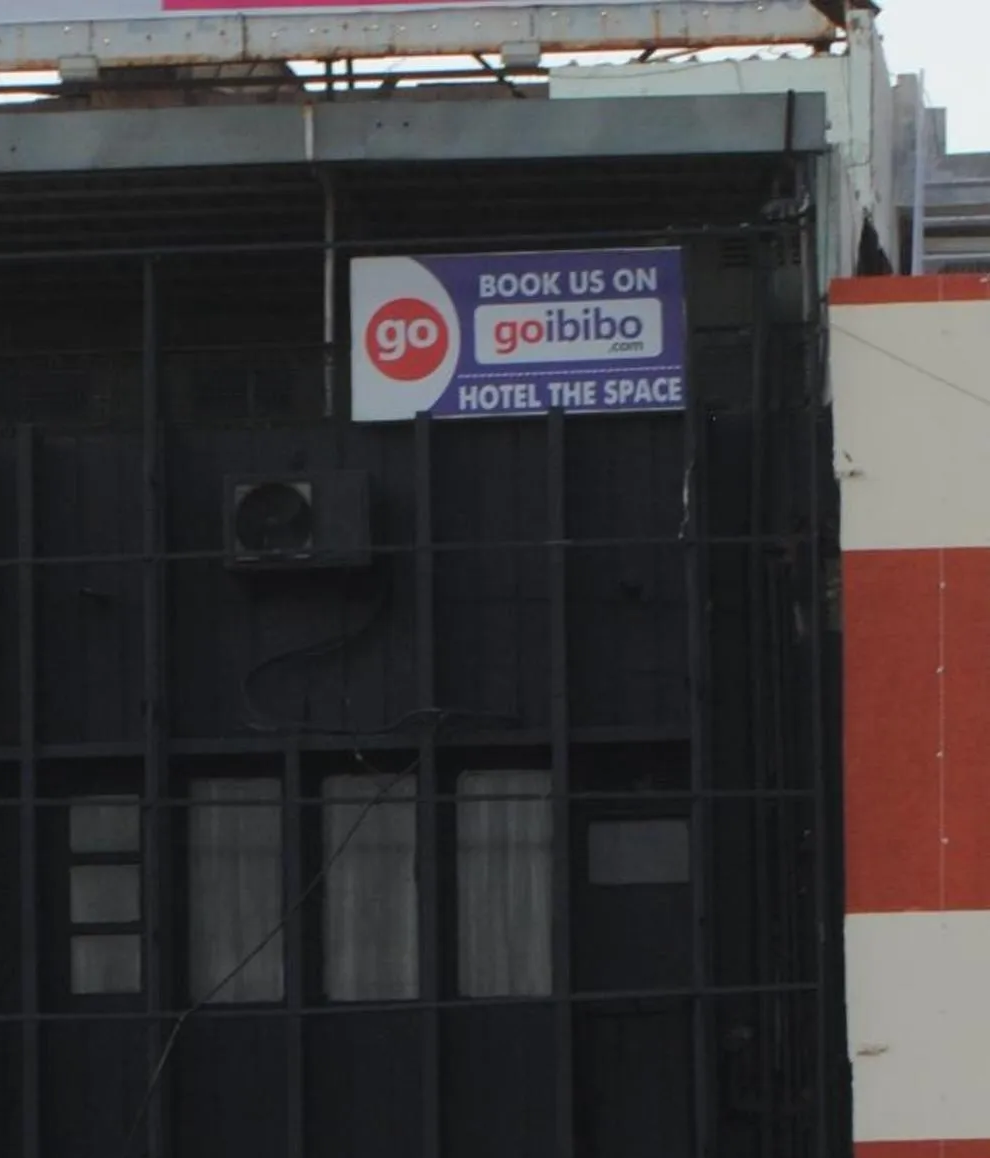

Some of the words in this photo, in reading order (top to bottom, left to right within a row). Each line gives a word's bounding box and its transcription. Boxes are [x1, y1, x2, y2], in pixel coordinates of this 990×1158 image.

[479, 271, 560, 298] BOOK
[569, 270, 604, 294] US
[612, 267, 657, 292] ON
[375, 316, 439, 361] go
[494, 308, 643, 354] goibibo
[458, 384, 541, 410] HOTEL
[548, 380, 596, 407] THE
[604, 377, 682, 405] SPACE
